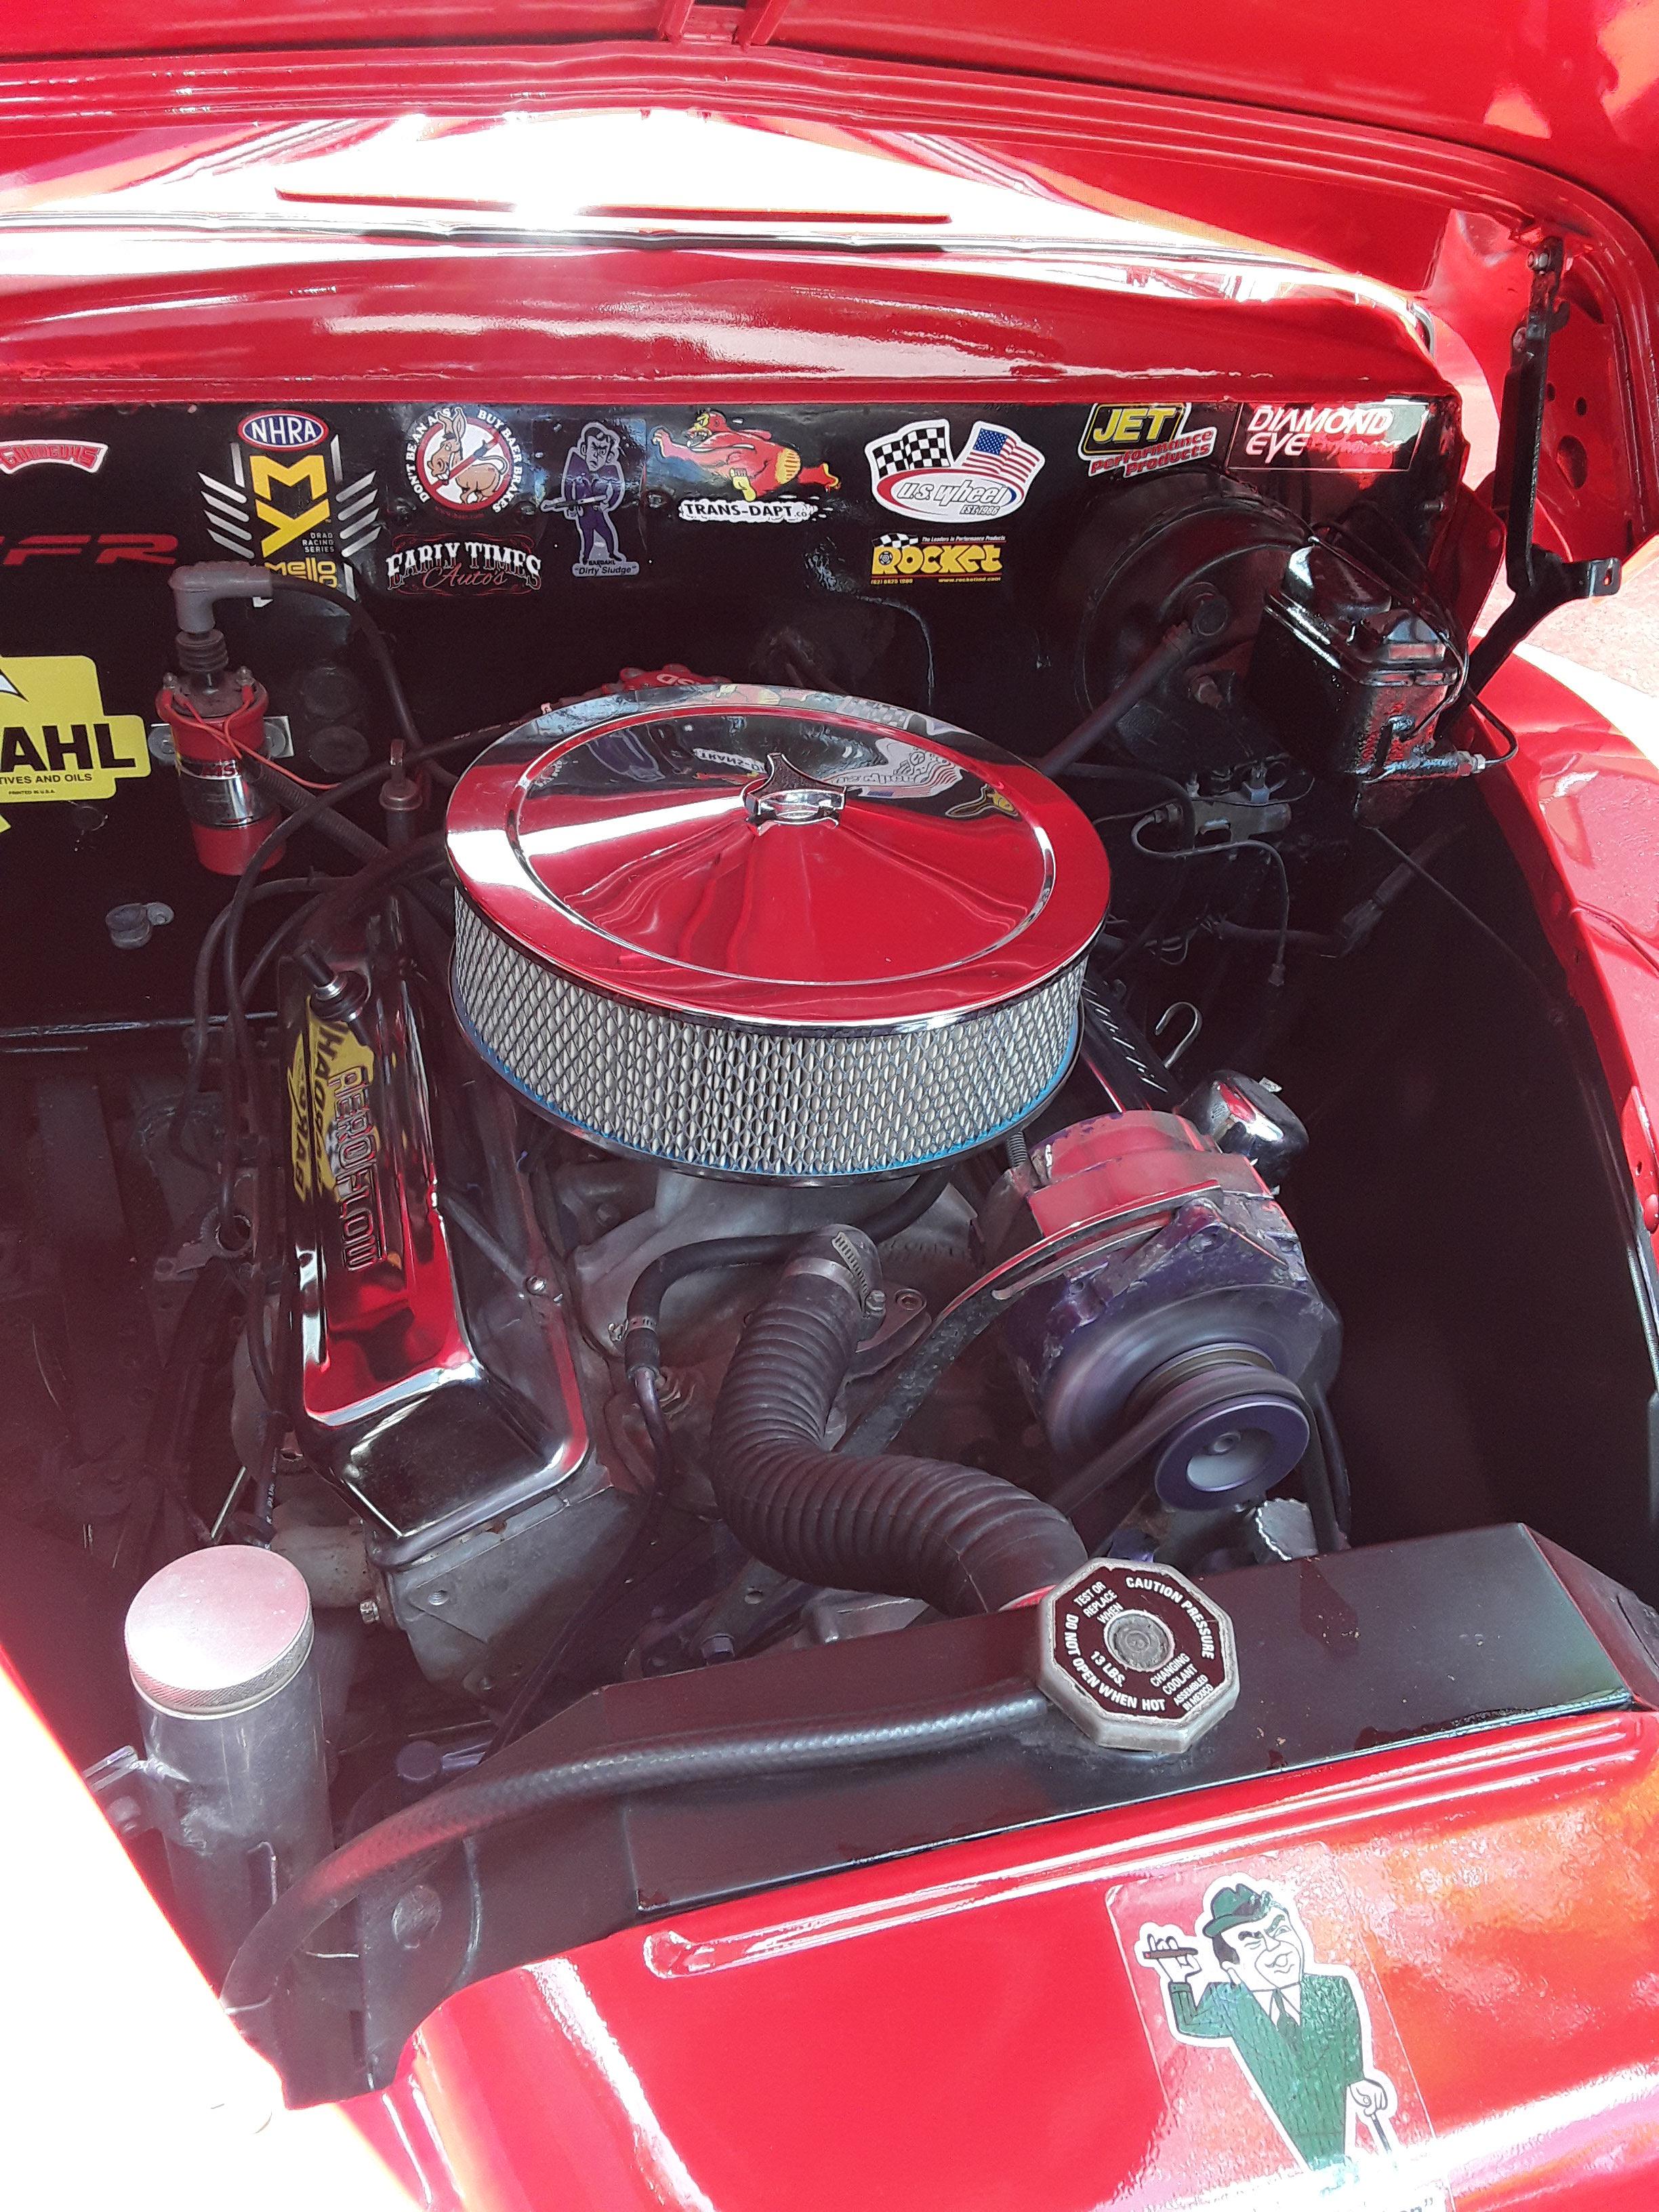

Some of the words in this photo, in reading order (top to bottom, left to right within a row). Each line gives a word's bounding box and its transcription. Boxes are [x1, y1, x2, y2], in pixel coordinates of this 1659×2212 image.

[251, 415, 316, 446] NHRA
[428, 408, 451, 427] AS
[477, 409, 504, 430] BUY
[1092, 408, 1176, 444] JET
[1247, 405, 1394, 434] DIAMOND
[412, 423, 428, 444] AN
[501, 427, 523, 464] BAER
[1246, 432, 1311, 464] EYE
[405, 443, 417, 462] BE
[492, 466, 523, 513] BRAKES
[386, 542, 460, 588] EARLY
[464, 542, 541, 590] TIMES
[423, 562, 508, 589] Auto's
[35, 775, 60, 783] AND
[64, 773, 93, 782] OILS
[329, 1065, 377, 1272] AEROFLOW
[1073, 1589, 1094, 1607] TEST
[1092, 1581, 1107, 1594] OR
[1083, 1589, 1118, 1618] REPLACE
[1065, 1614, 1079, 1630] DO
[1097, 1602, 1124, 1624] WHEN
[1126, 1577, 1183, 1603] CAUTION
[1181, 1600, 1214, 1660] PRESSURE
[1064, 1632, 1081, 1656] NOT
[1073, 1658, 1101, 1688] OPEN
[1090, 1651, 1106, 1666] 13
[1102, 1662, 1126, 1687] LBS.
[1150, 1653, 1191, 1687] CHANGING
[1162, 1663, 1198, 1695] COOLANT
[1099, 1682, 1138, 1709] WHEN
[1142, 1698, 1166, 1711] HOT
[1173, 1674, 1208, 1706] ASSEMBLED
[1182, 1700, 1193, 1711] IN
[1189, 1683, 1214, 1705] MEXICO
